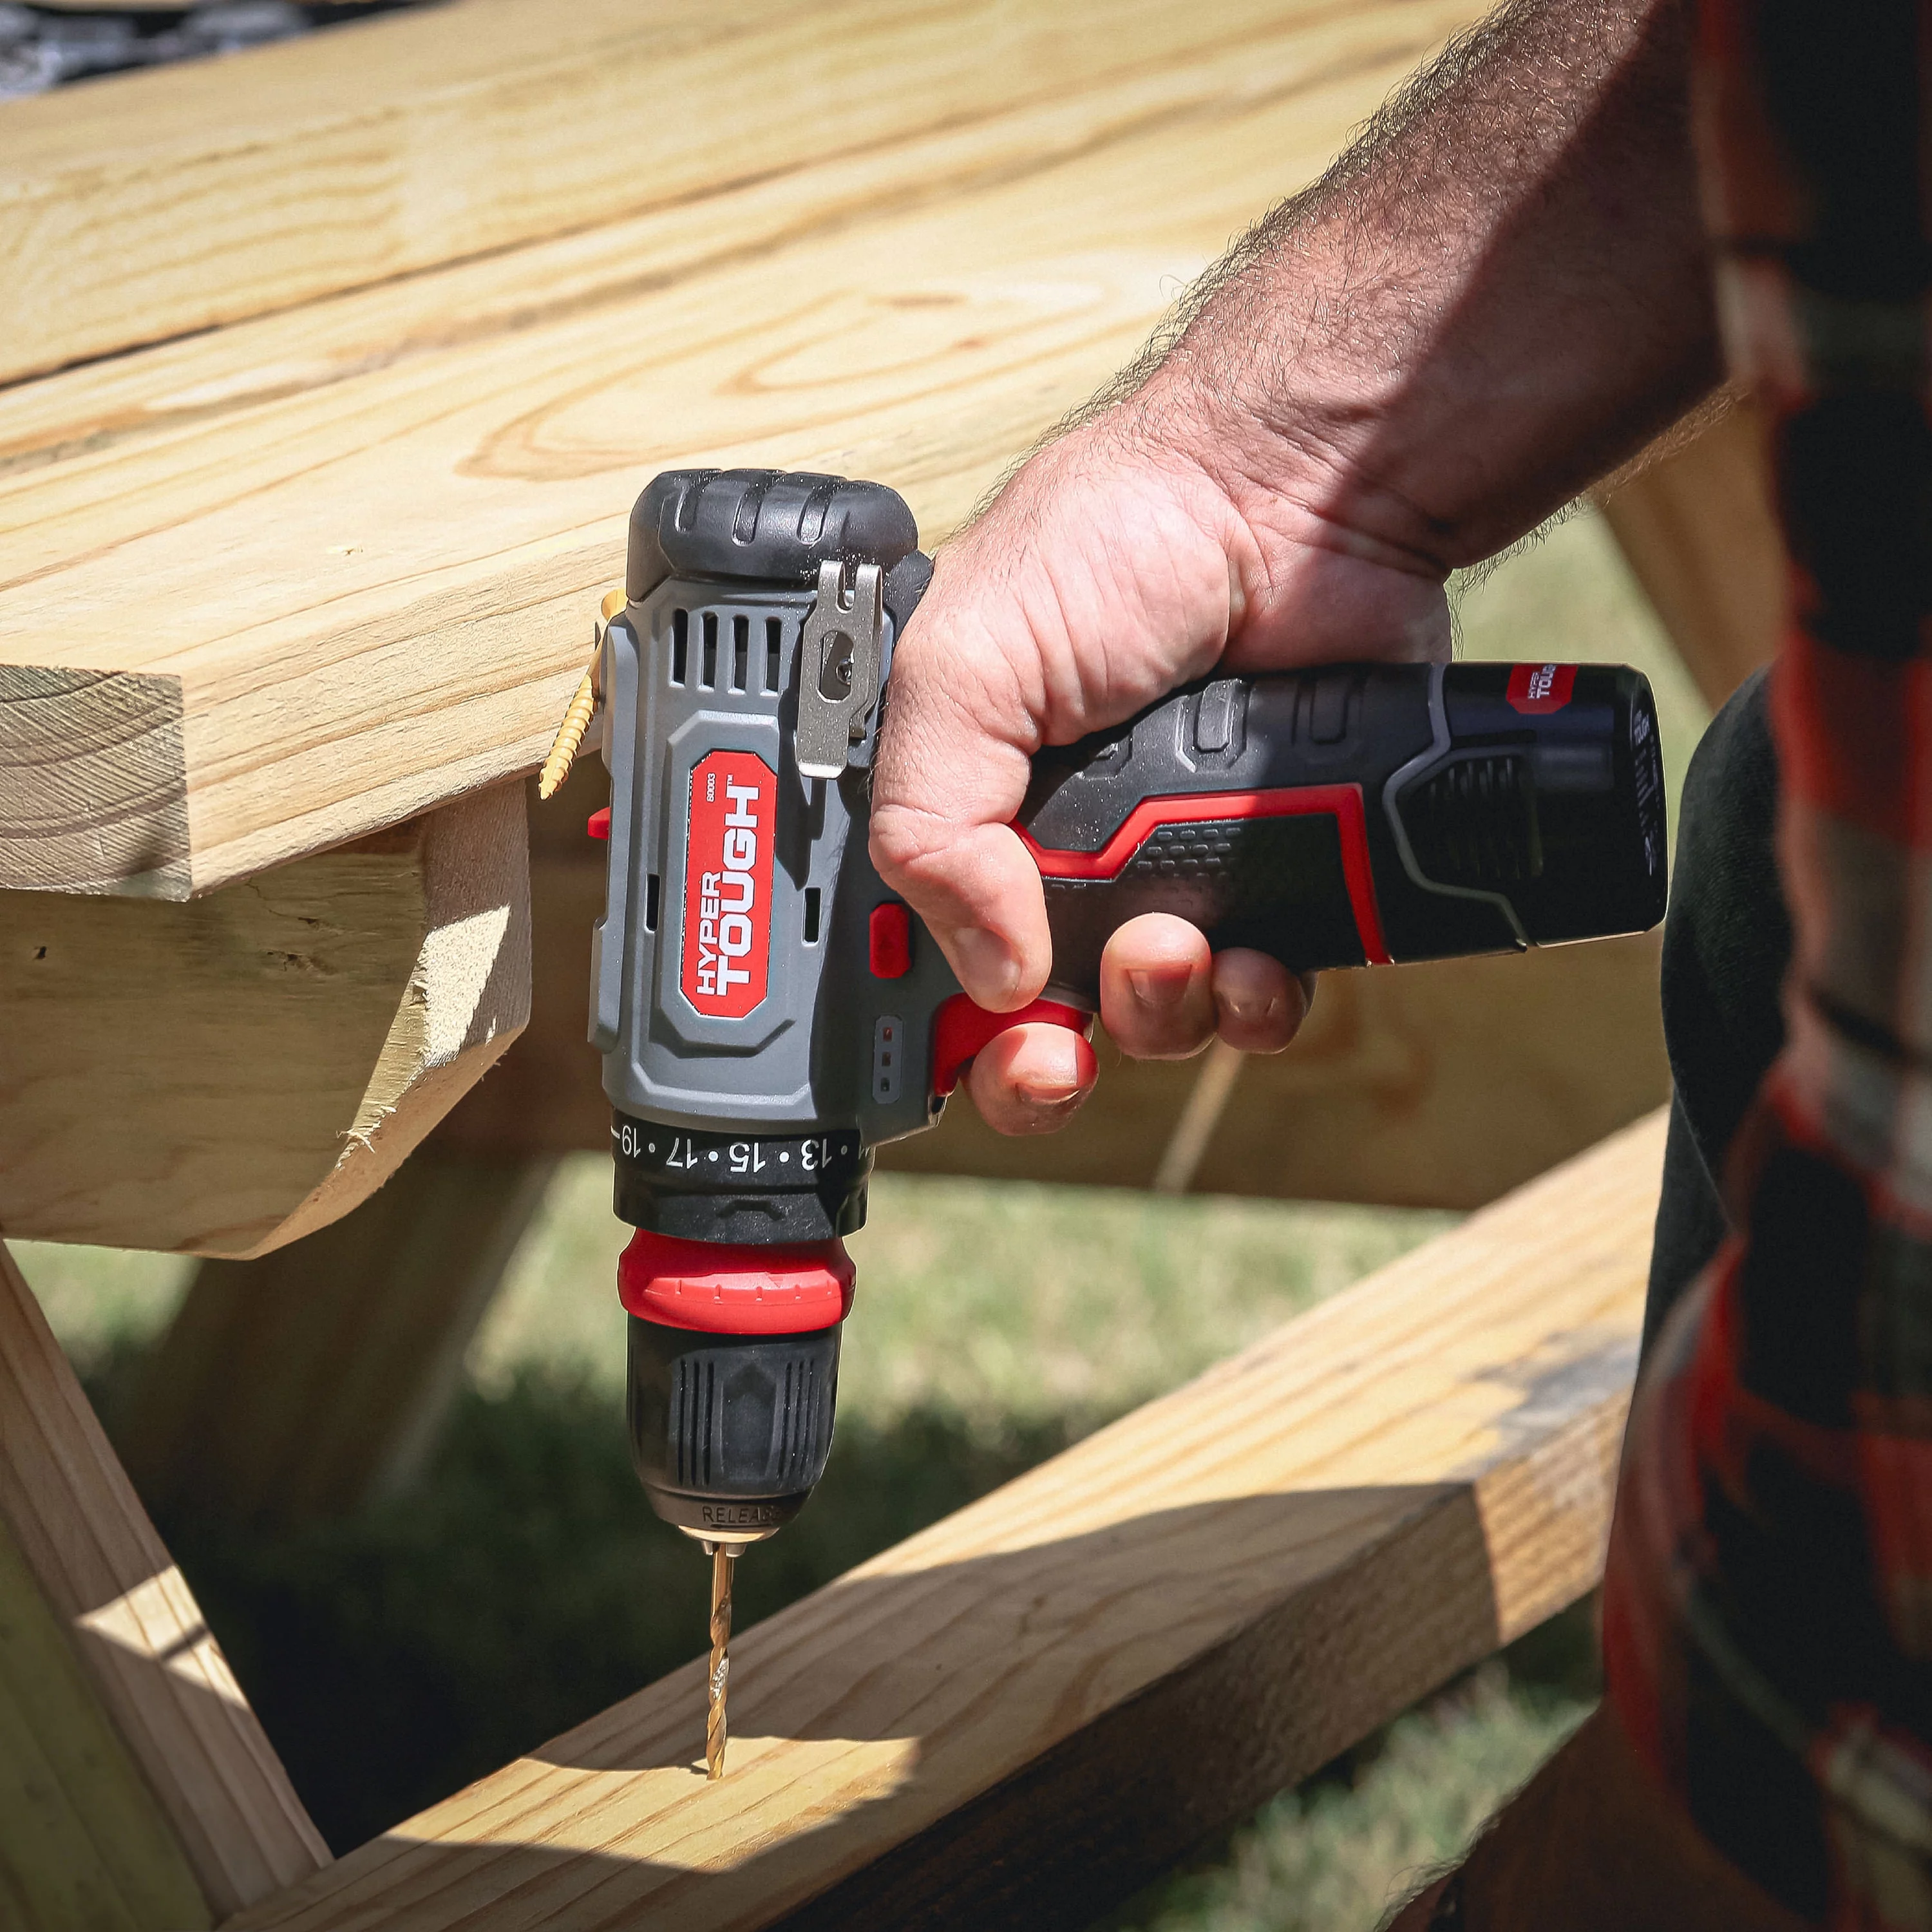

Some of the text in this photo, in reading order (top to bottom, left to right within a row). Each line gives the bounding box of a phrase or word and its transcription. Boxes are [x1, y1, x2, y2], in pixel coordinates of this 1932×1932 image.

[696, 871, 721, 995] HYPER
[715, 785, 760, 996] TOUGH
[621, 1124, 833, 1173] 13 15 17 19
